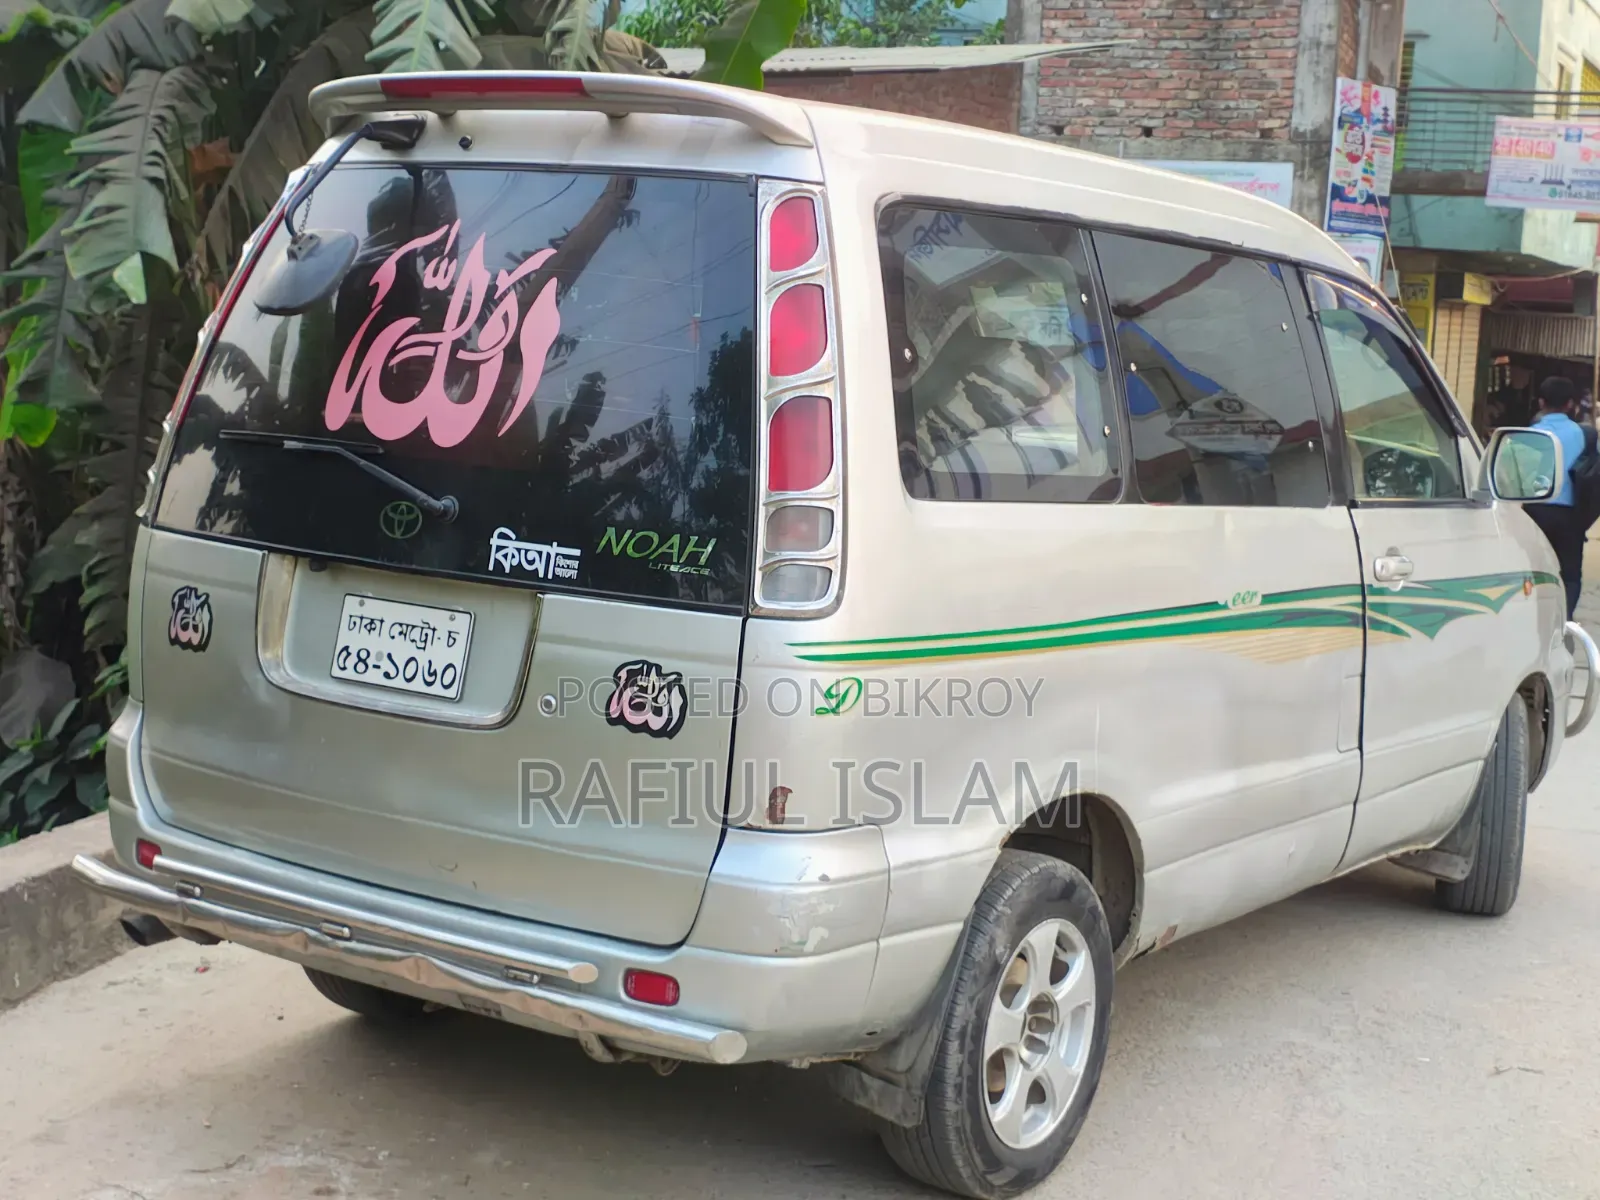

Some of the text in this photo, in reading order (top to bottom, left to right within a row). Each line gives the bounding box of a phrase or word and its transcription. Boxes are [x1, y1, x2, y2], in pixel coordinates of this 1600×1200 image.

[596, 526, 717, 566] NOAH
[554, 567, 578, 580] আলো
[648, 561, 711, 576] LITEACE
[347, 614, 385, 638] ঢাকা
[337, 645, 457, 690] ৫৪-১০৬০
